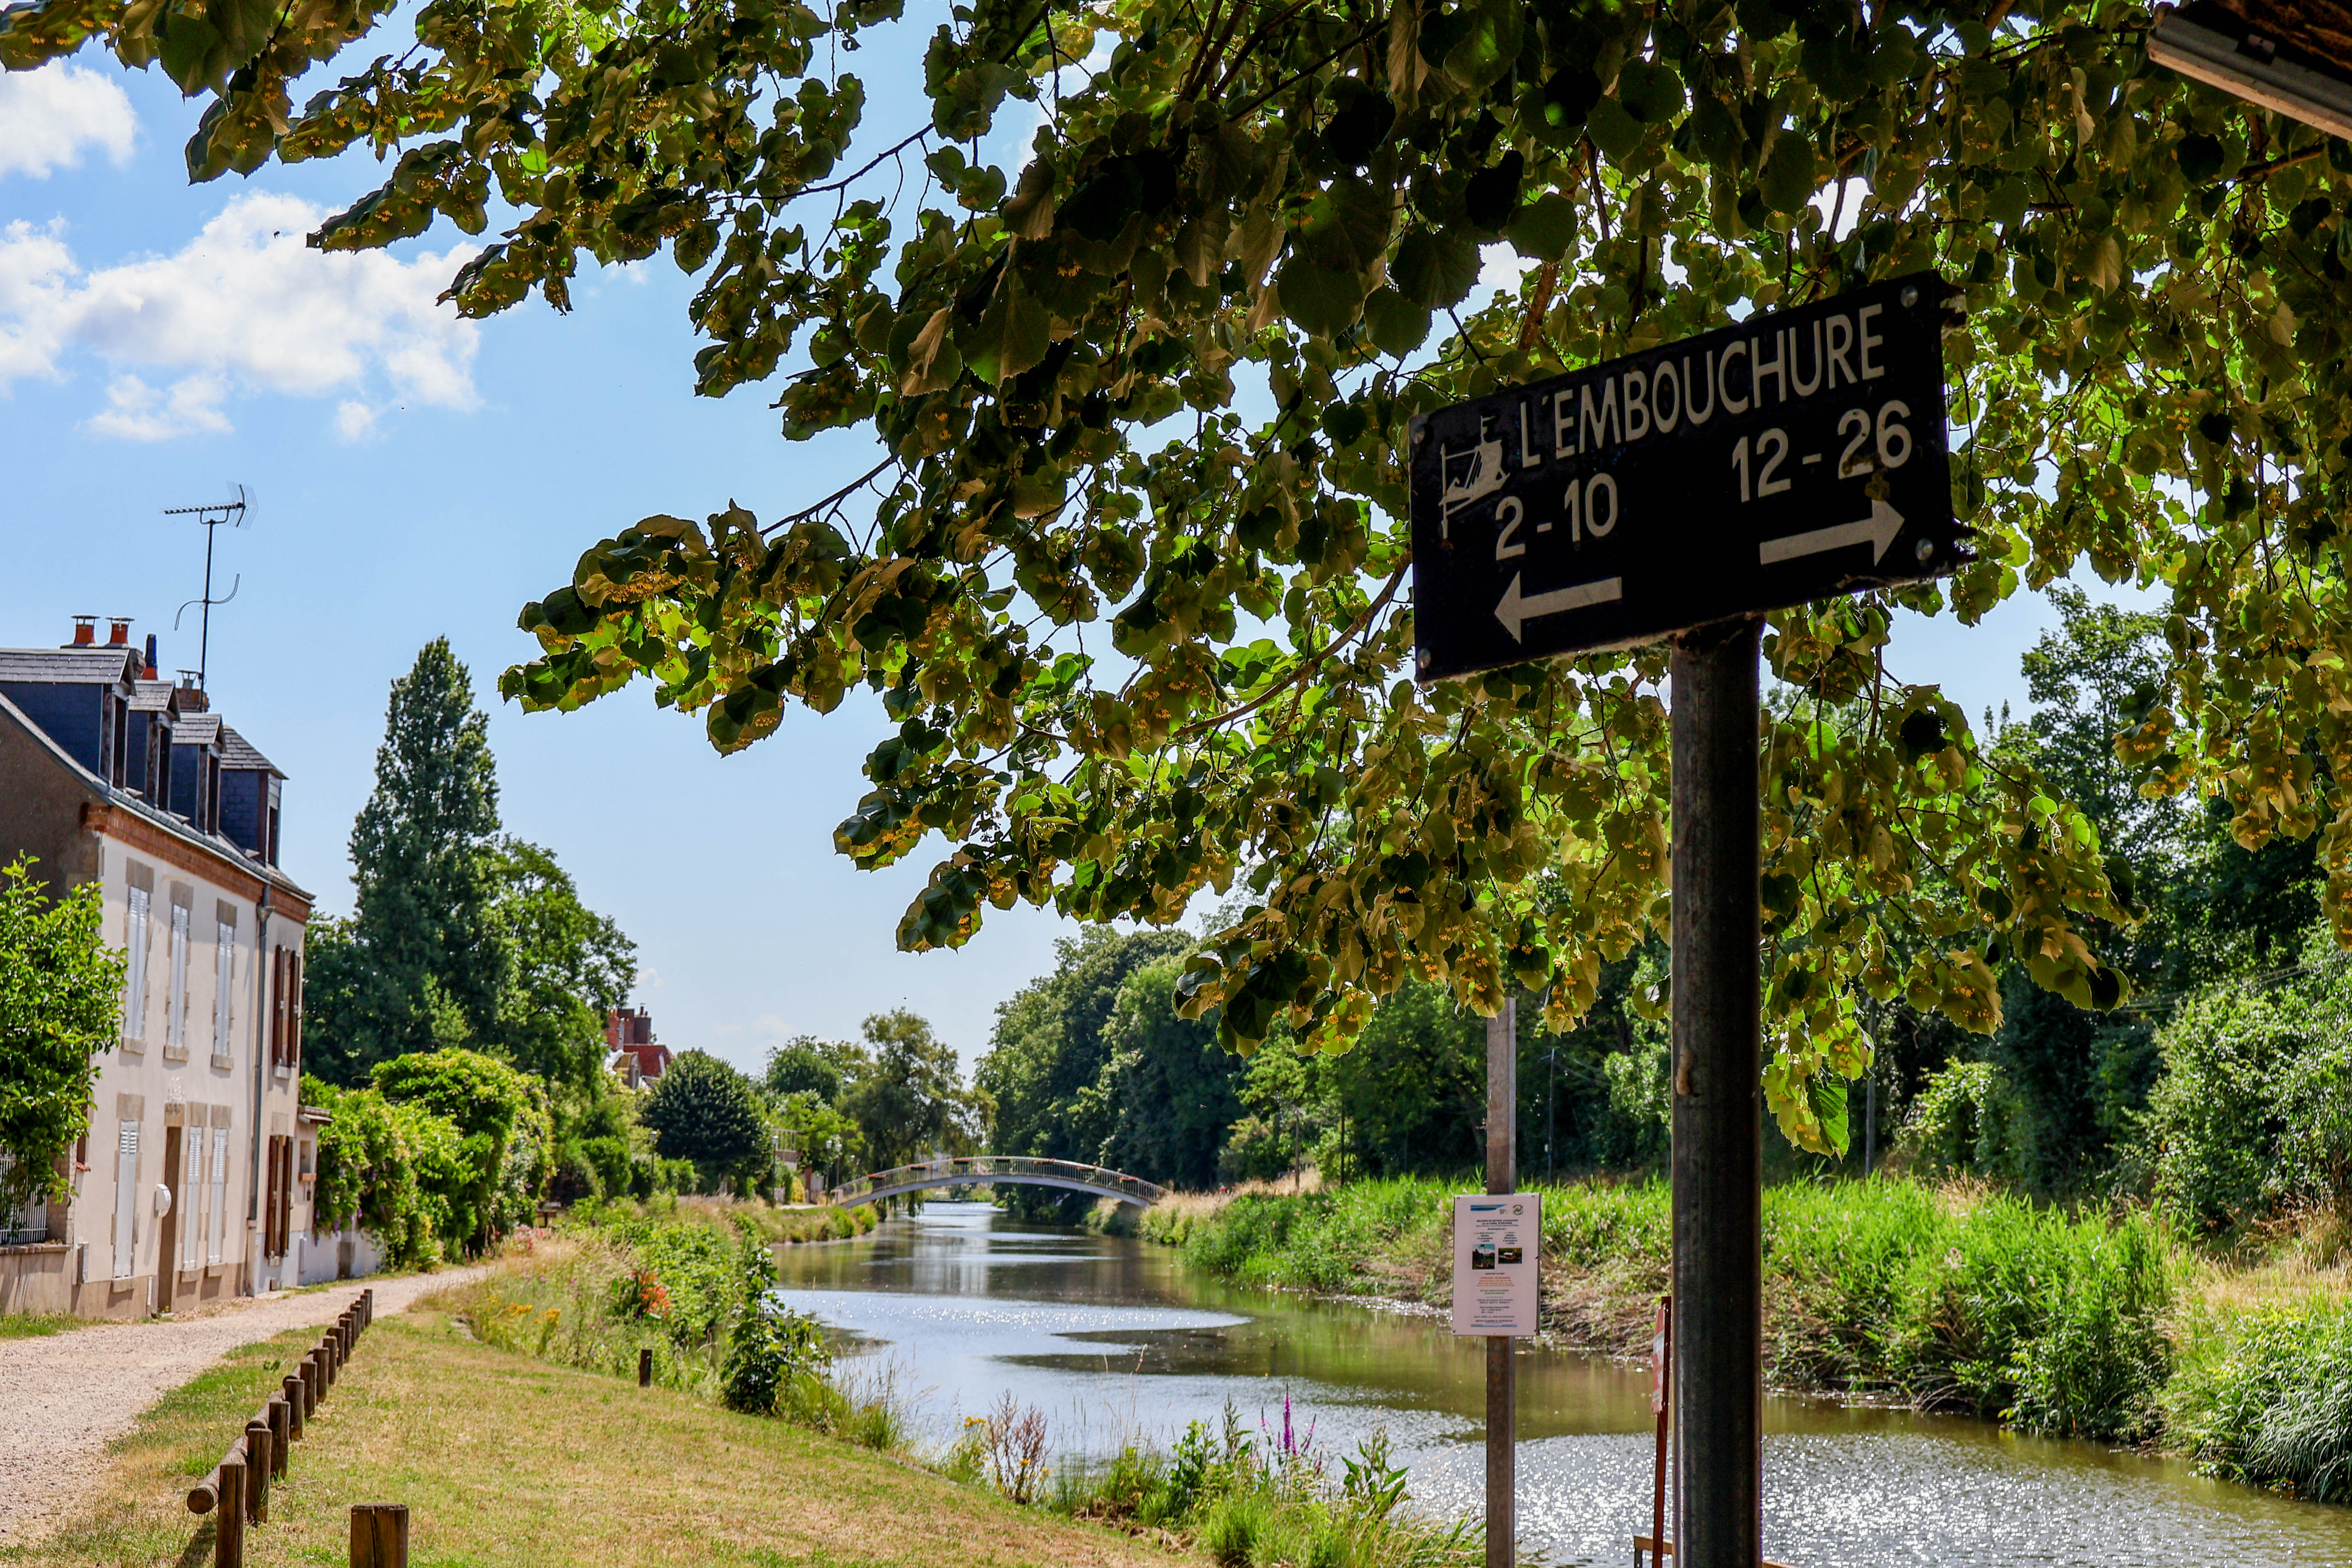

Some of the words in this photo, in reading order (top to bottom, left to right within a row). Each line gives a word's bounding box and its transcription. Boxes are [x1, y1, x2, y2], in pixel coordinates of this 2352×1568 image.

[1520, 303, 1885, 468] L'EMBOUCHURE
[1732, 427, 1791, 502] 12
[1838, 400, 1912, 480] 26
[1495, 496, 1525, 561] 2
[1564, 473, 1618, 542] 10
